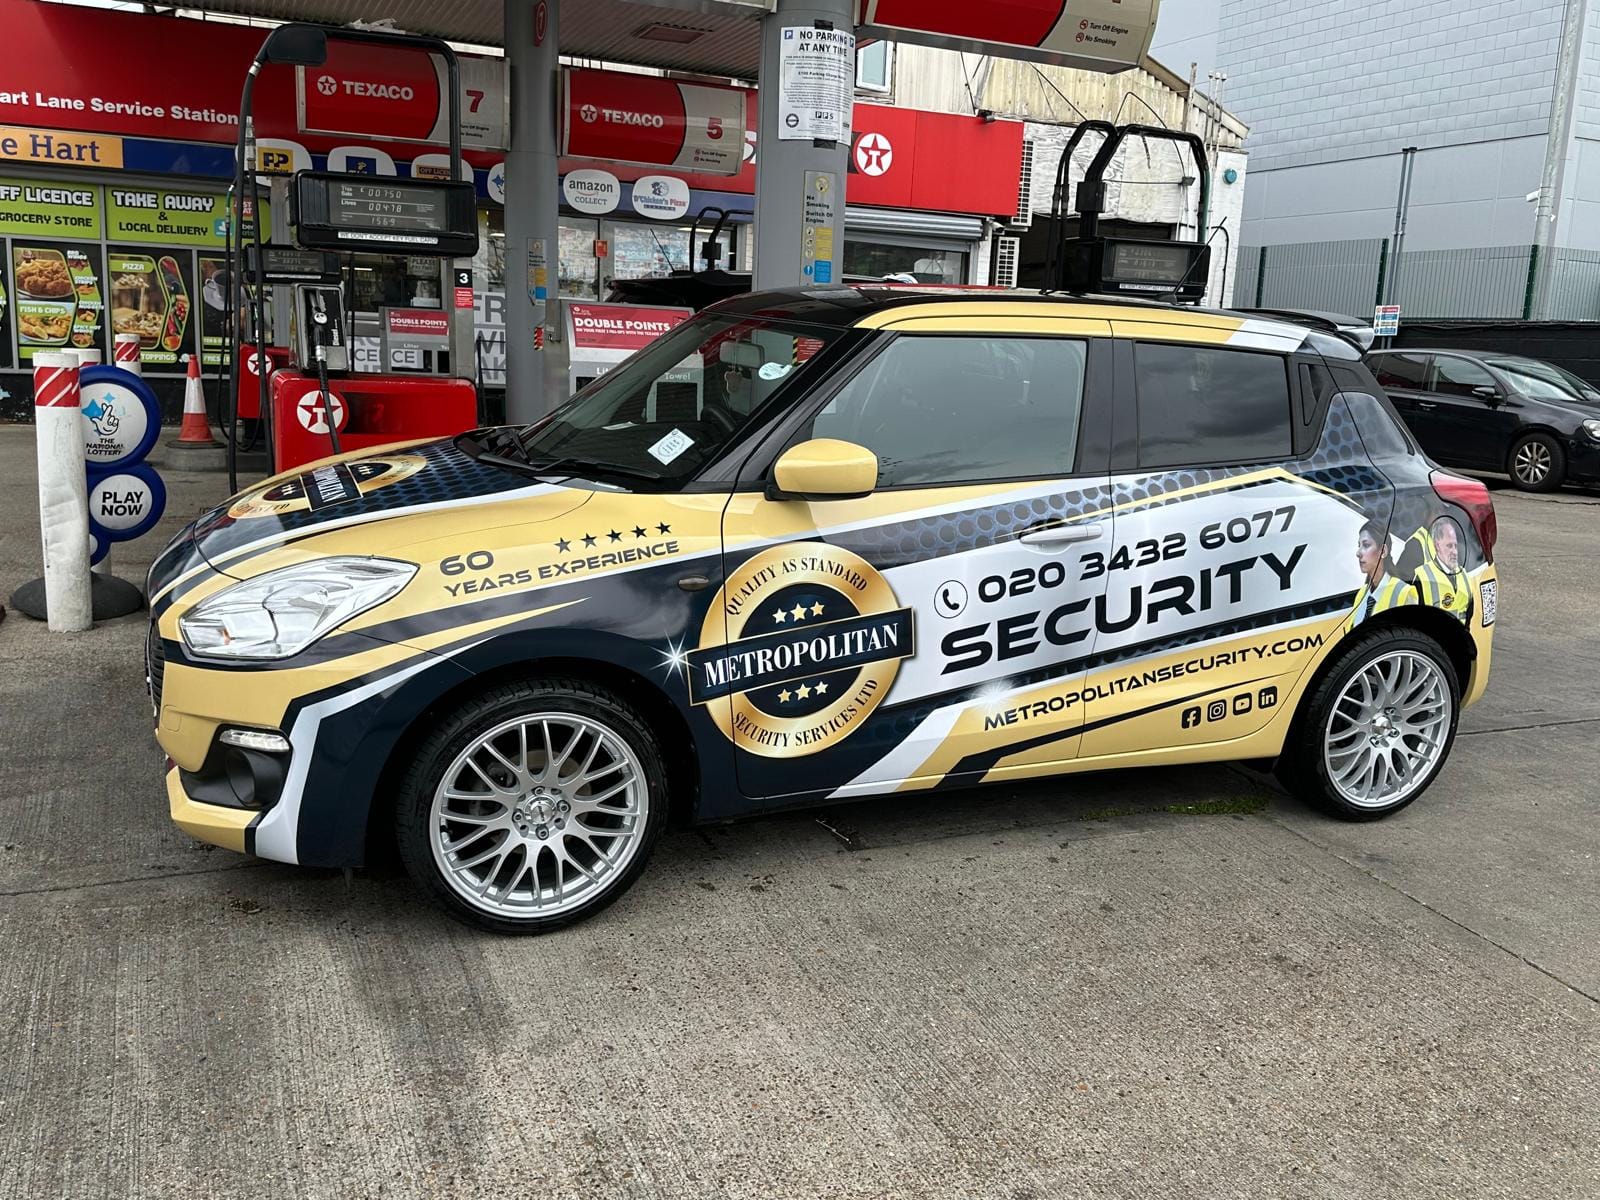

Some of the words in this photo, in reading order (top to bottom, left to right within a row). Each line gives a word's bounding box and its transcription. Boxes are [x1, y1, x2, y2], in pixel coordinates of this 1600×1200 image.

[800, 31, 812, 39] NO
[816, 31, 848, 45] PARKING
[1111, 26, 1129, 34] Engine
[1094, 36, 1116, 46] Smoking
[799, 43, 810, 51] AT
[812, 44, 831, 52] ANY
[833, 45, 847, 57] TIME
[342, 80, 414, 100] TEXACO
[36, 92, 85, 110] Lane
[90, 98, 165, 117] Service
[171, 105, 239, 125] Station
[466, 90, 484, 113] 7
[602, 109, 664, 128] TEXACO
[706, 117, 724, 140] 5
[29, 134, 101, 163] Hart
[569, 179, 613, 193] amazon
[25, 187, 93, 206] LICENCE
[112, 191, 158, 209] TAKE
[164, 194, 214, 212] AWAY
[574, 196, 607, 206] COLLECT
[0, 212, 51, 224] GROCERY
[55, 216, 93, 227] STORE
[158, 212, 168, 221] &
[119, 222, 154, 233] LOCAL
[156, 224, 208, 236] DELIVERY
[122, 263, 145, 271] PIZZA
[459, 272, 469, 284] 3
[390, 317, 419, 325] DOUBLE
[574, 317, 624, 329] DOUBLE
[625, 320, 671, 331] POINTS
[665, 372, 690, 380] Towel
[102, 492, 144, 503] PLAY
[101, 504, 143, 516] NOW
[978, 561, 1066, 604] 020
[1079, 532, 1187, 581] 3432
[1199, 504, 1297, 550] 6077
[440, 550, 494, 576] 60
[444, 568, 532, 597] YEARS
[538, 540, 680, 580] EXPERIENCE
[725, 565, 777, 616] QUALITY
[782, 558, 797, 574] AS
[800, 557, 868, 592] STANDARD
[940, 543, 1309, 676] SECURITY
[703, 622, 899, 688] METROPOLITAN
[984, 632, 1325, 732] METROPOLITANSECURITY.COM
[733, 711, 791, 748] SECURITY
[795, 703, 858, 747] SERVICES
[856, 679, 878, 706] LTD
